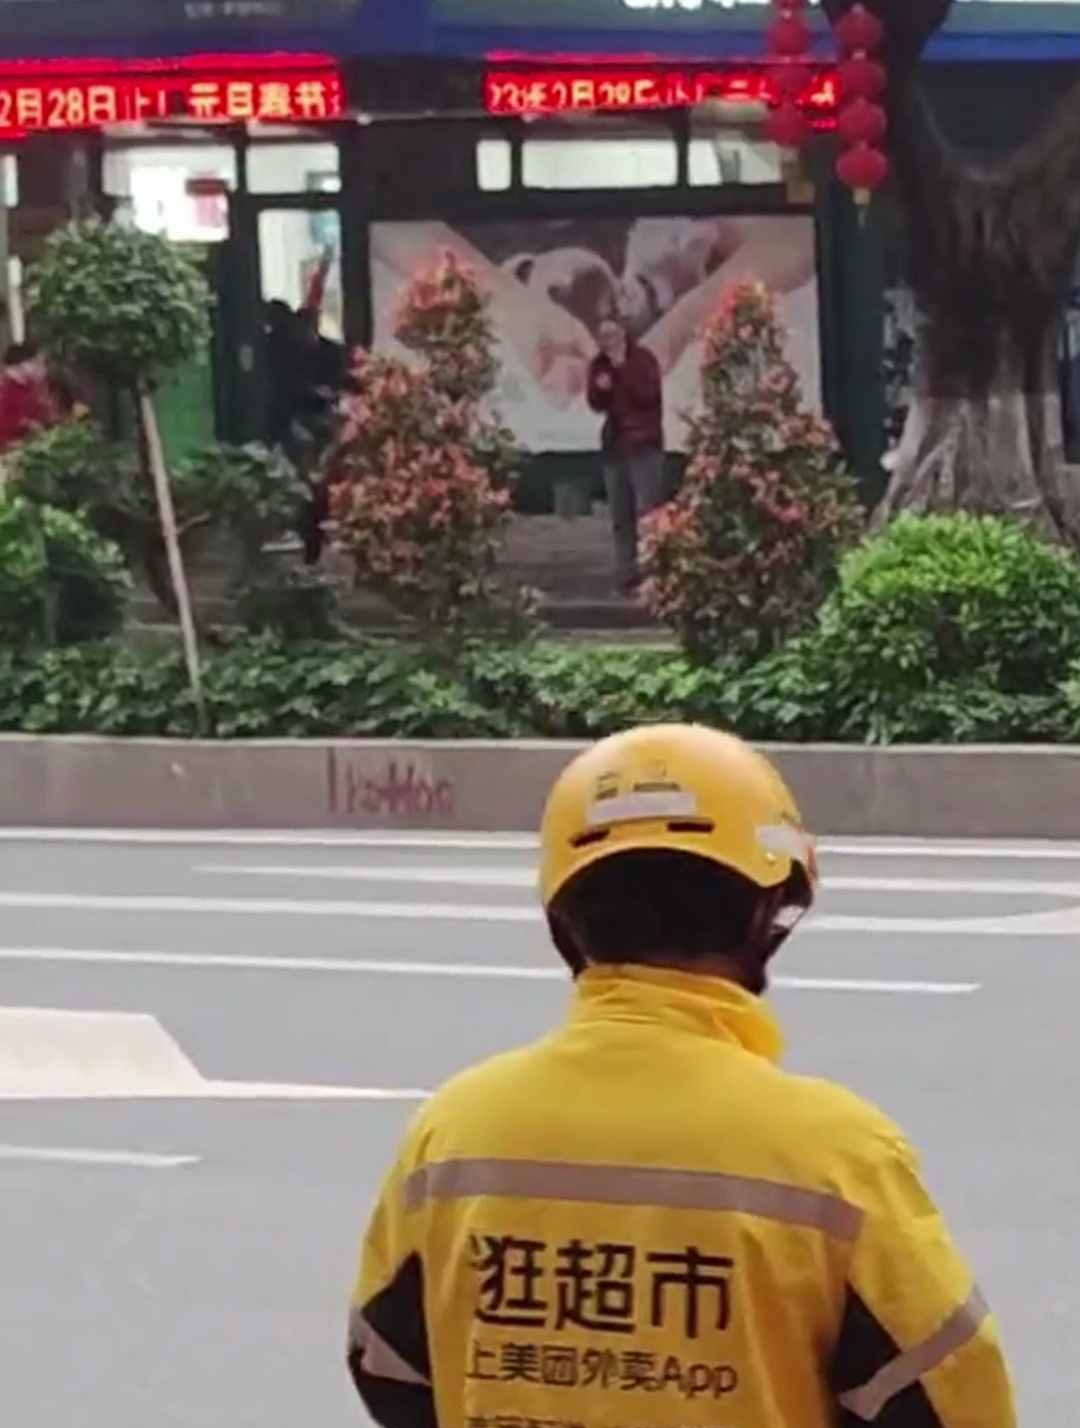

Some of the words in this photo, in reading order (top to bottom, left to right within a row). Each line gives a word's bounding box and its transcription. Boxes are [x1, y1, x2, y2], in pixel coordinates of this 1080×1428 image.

[468, 1234, 735, 1339] 逛超市
[464, 1343, 739, 1400] 上美团外卖App
